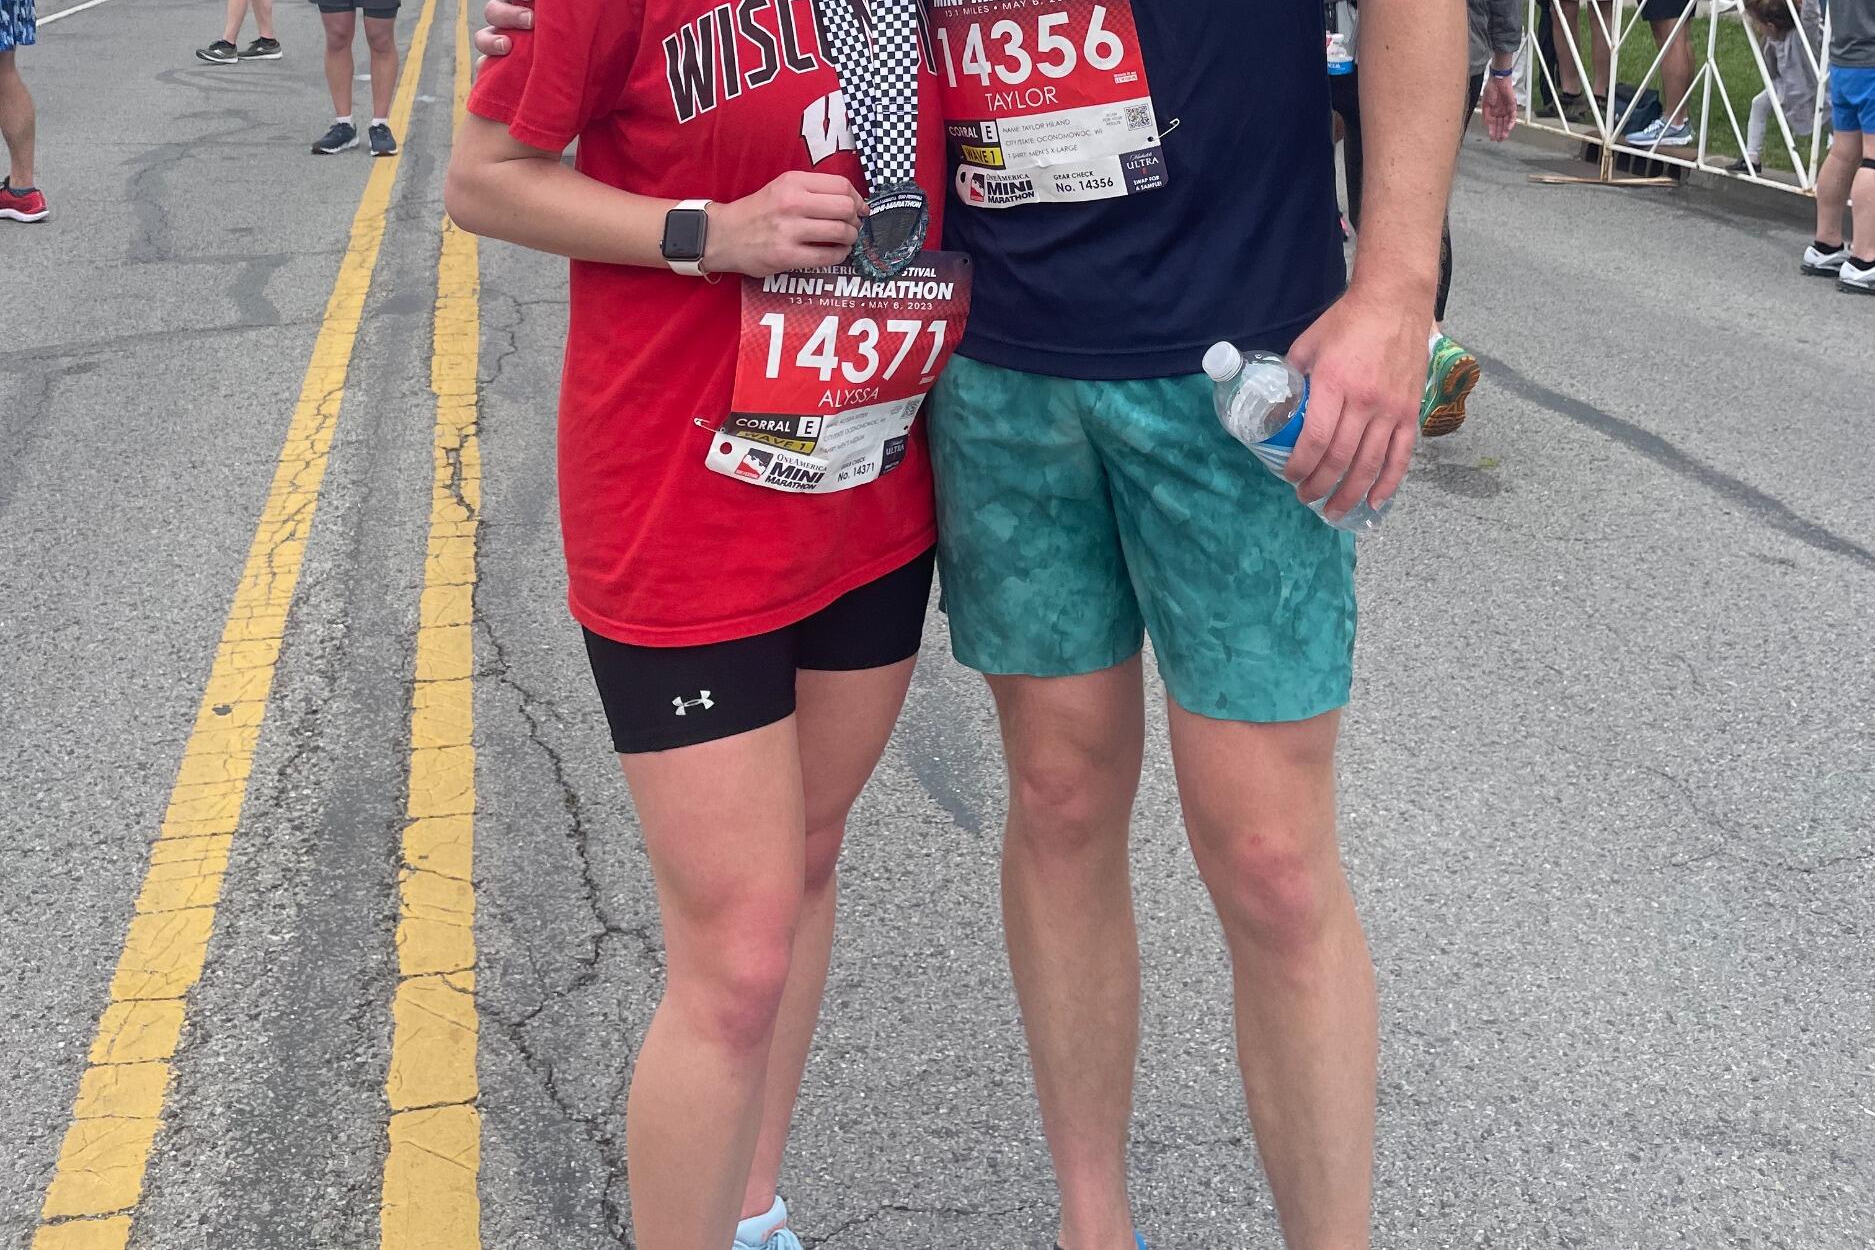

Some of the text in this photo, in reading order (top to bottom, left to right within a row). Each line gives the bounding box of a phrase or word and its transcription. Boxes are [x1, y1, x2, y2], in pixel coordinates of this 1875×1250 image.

[963, 5, 990, 15] MILES
[1002, 0, 1027, 10] MAY
[937, 4, 1125, 88] 14356
[985, 86, 1059, 113] TAYLOR
[985, 125, 993, 140] E
[966, 149, 996, 164] WAVE 1
[1126, 156, 1160, 170] ULTRA
[1053, 170, 1095, 181] GEAR CHECK
[986, 179, 1034, 196] MINI
[1055, 176, 1114, 193] No. 14356
[987, 191, 1035, 204] MARATHON
[901, 266, 937, 278] STIVAL
[763, 273, 955, 301] MINI-MARATHON
[819, 298, 856, 309] MILES
[868, 302, 889, 310] MAY
[907, 302, 933, 311] 2023
[759, 312, 948, 384] 14371
[818, 387, 880, 409] ALYSSA
[735, 418, 791, 433] CORRAL
[804, 420, 814, 435] E
[744, 432, 795, 449] WAVE
[799, 442, 806, 451] 1
[769, 461, 826, 484] MINI
[837, 471, 851, 483] No.
[853, 462, 875, 477] 14371
[764, 474, 817, 491] MARATHON
